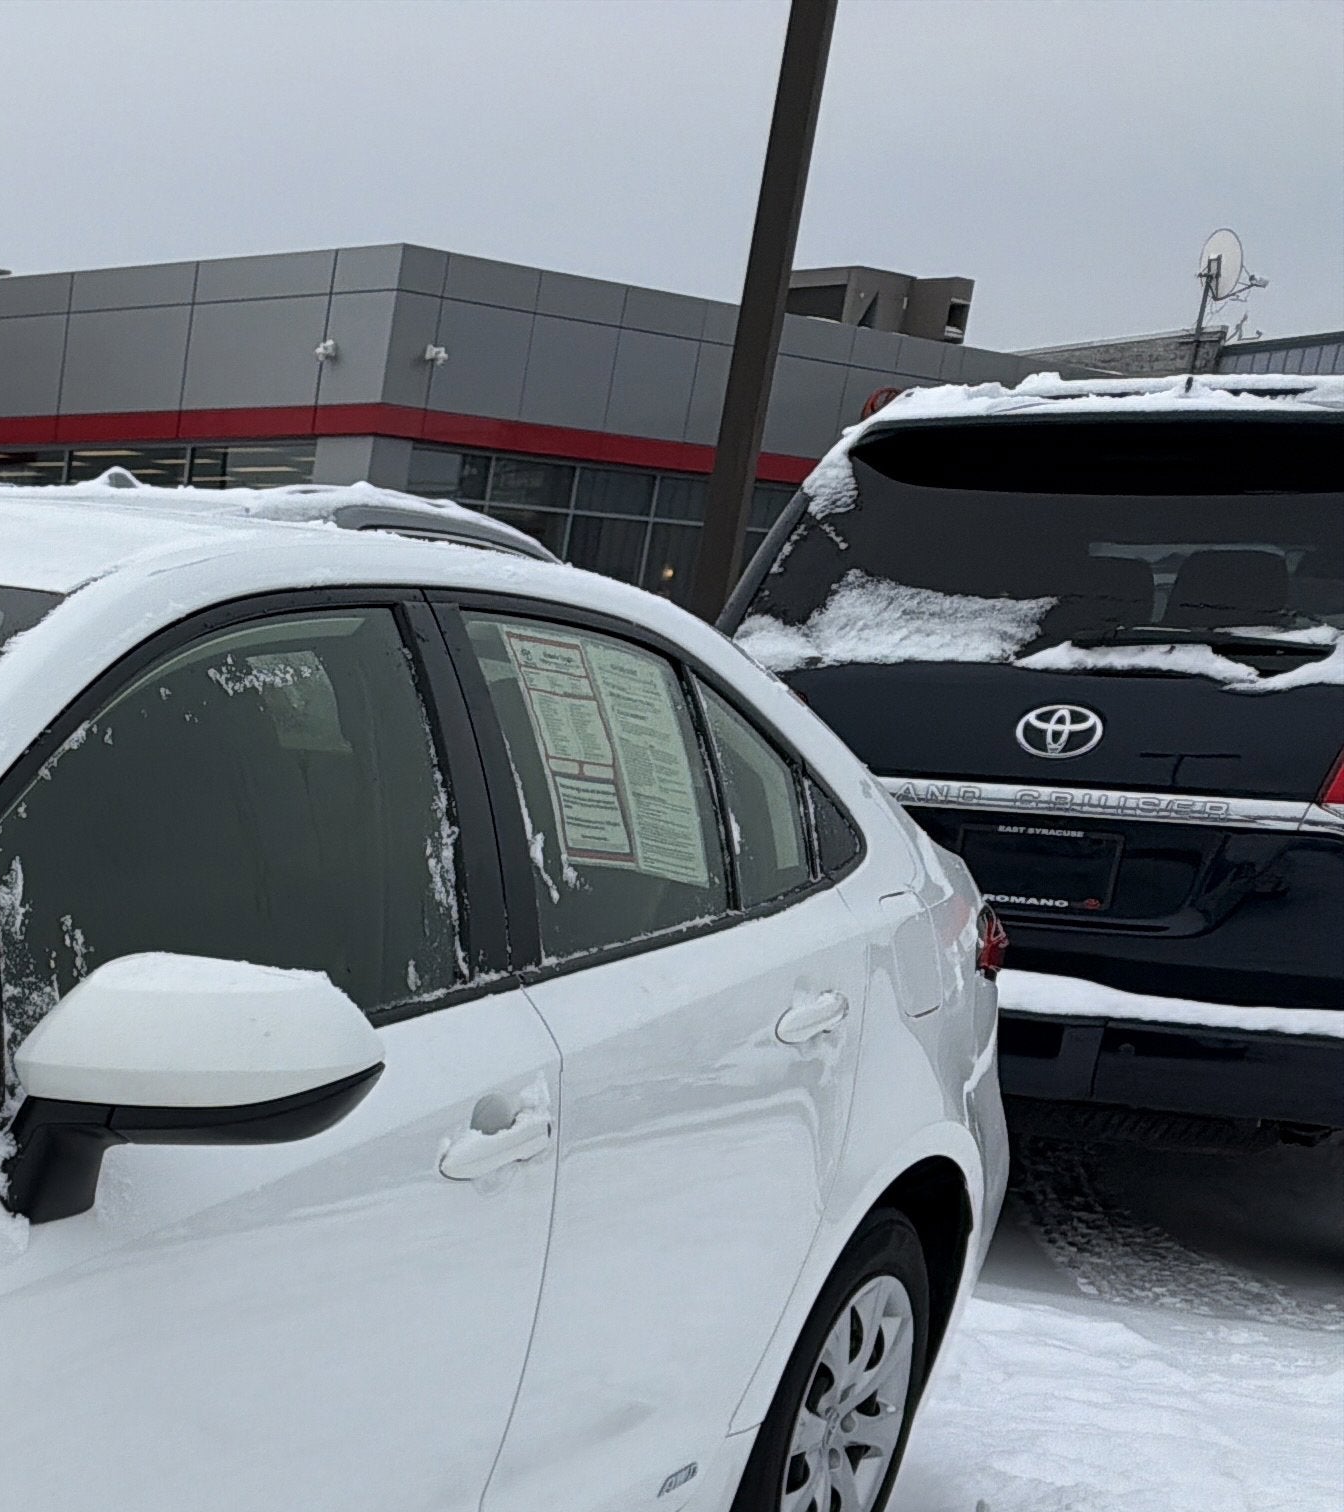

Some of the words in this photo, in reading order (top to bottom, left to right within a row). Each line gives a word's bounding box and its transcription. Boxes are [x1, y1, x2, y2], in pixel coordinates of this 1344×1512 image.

[894, 781, 983, 804] AND
[1015, 788, 1231, 822] CRUISER
[997, 825, 1026, 834] EAST
[1027, 828, 1085, 838] SYRACUSE
[982, 893, 1069, 908] ROMANO
